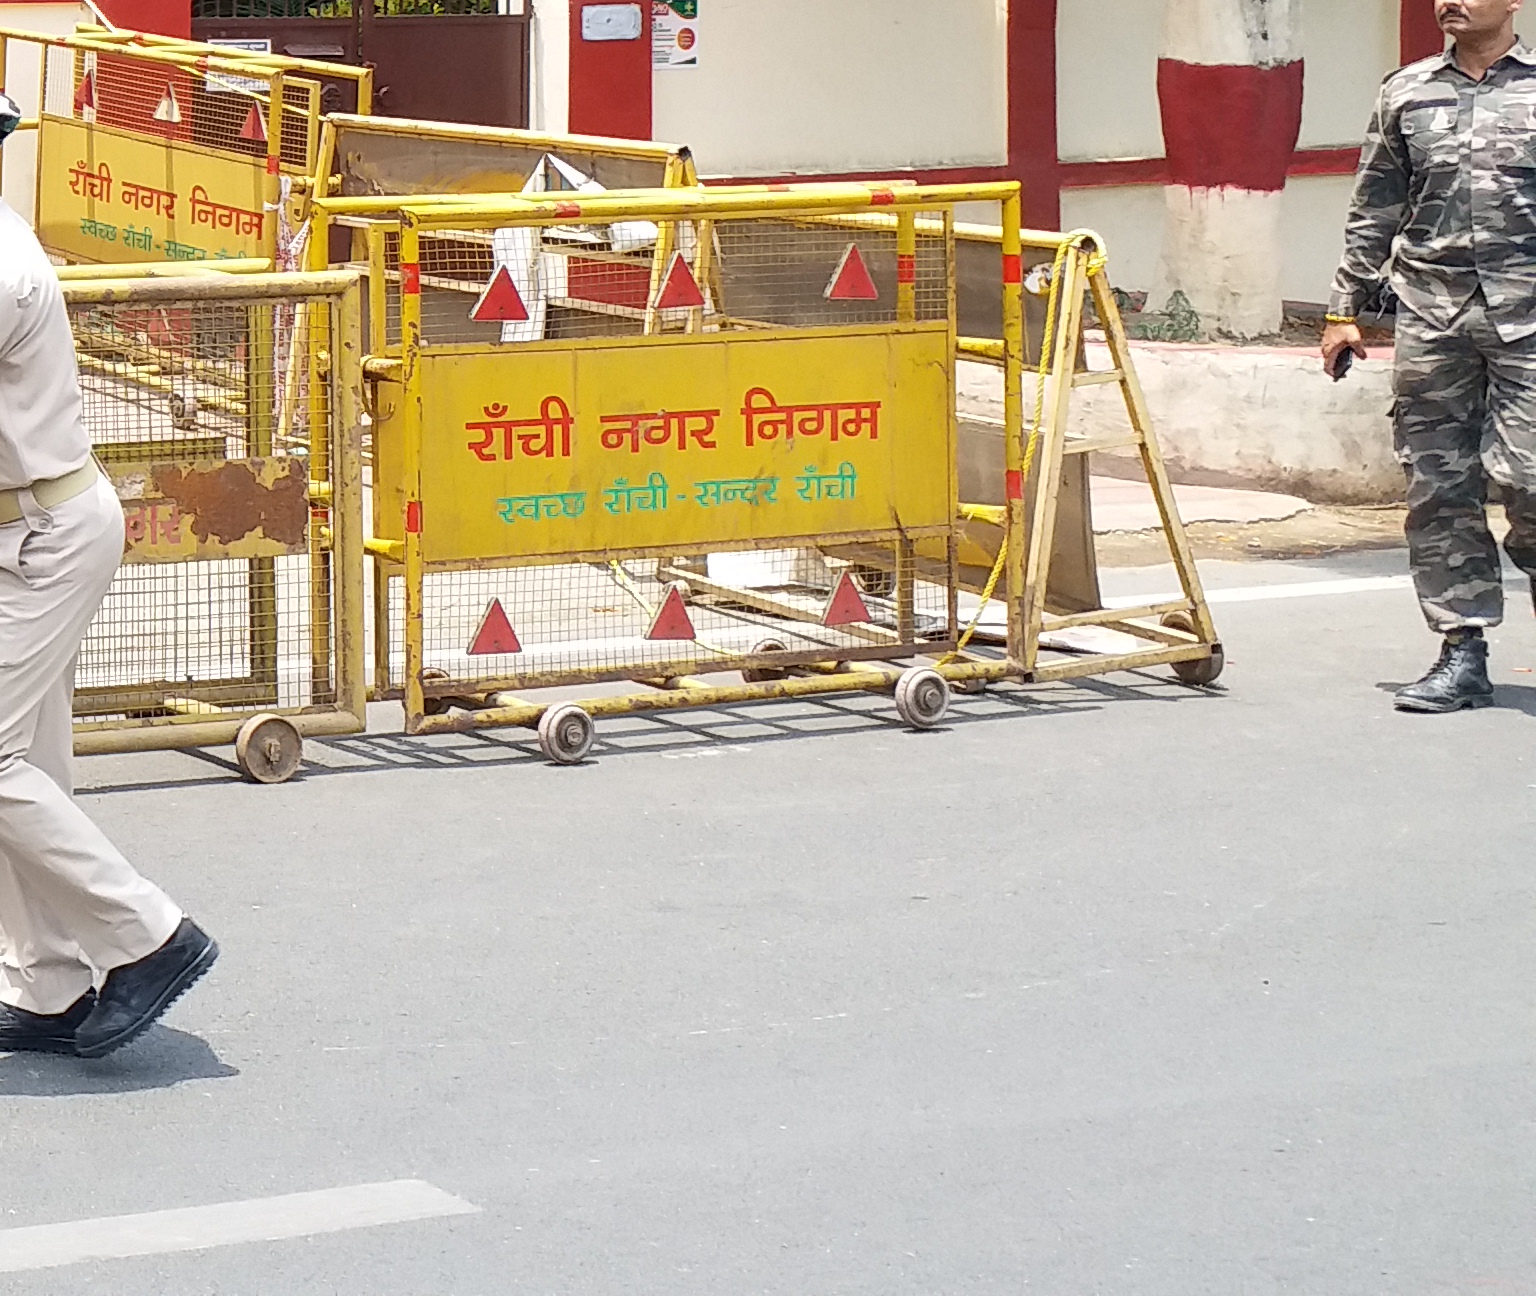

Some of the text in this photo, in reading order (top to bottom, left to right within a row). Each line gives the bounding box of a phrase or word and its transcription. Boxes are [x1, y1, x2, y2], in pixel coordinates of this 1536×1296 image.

[68, 159, 265, 241] राँची नगर निगम
[122, 223, 153, 253] राँची
[465, 387, 881, 462] राँची नगर निगम
[496, 491, 587, 523] स्वच्छ
[602, 472, 669, 515] राँची
[795, 461, 857, 502] राँची
